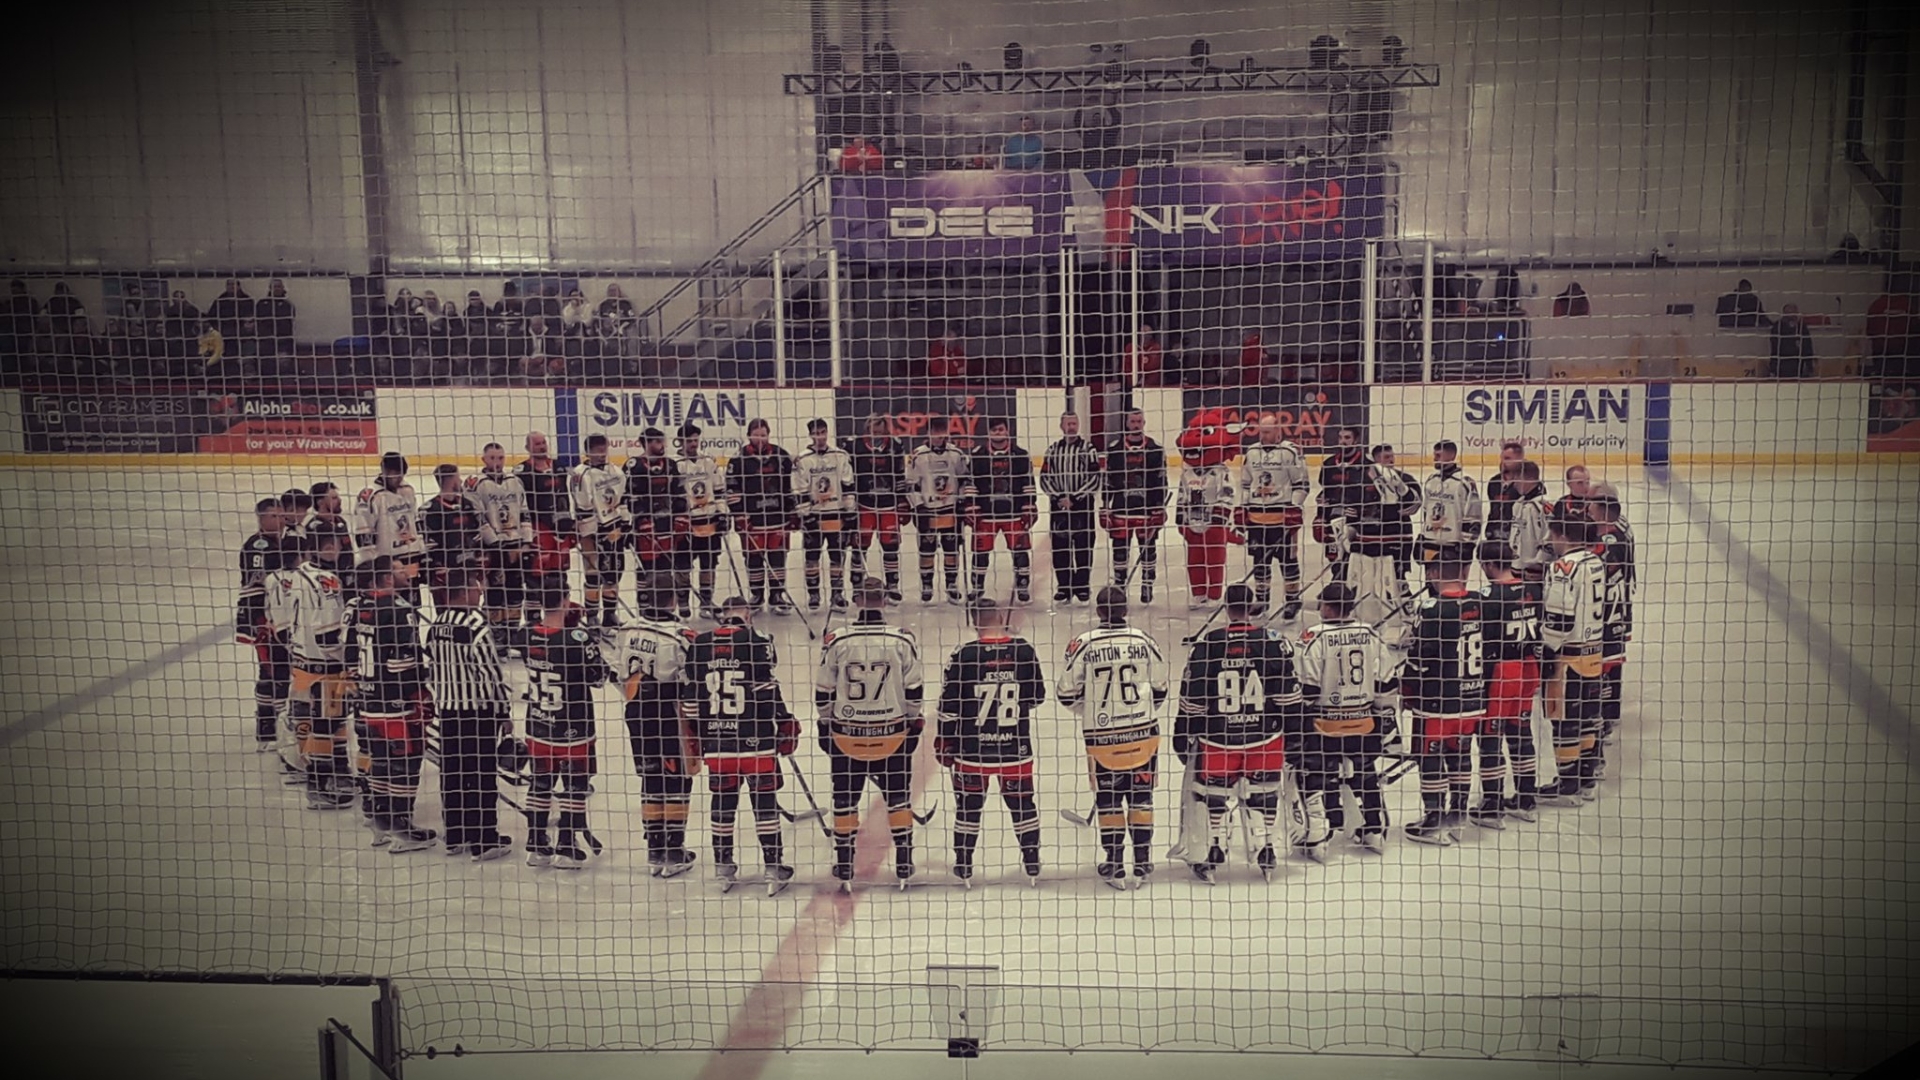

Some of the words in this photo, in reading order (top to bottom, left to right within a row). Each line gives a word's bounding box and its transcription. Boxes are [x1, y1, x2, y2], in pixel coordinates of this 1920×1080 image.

[890, 206, 1033, 237] DEE
[1065, 205, 1222, 235] RNK
[593, 392, 746, 427] SIMIAN
[1465, 389, 1630, 424] SIMIAN
[246, 439, 264, 449] for
[267, 440, 294, 451] your
[297, 438, 367, 449] Warehouse
[1465, 436, 1494, 447] Your
[1548, 435, 1572, 447] Our
[1337, 650, 1364, 686] 18
[1457, 633, 1483, 678] 18
[846, 662, 890, 701] 67
[983, 671, 1015, 682] JESSON
[1094, 664, 1140, 709] 76
[1218, 670, 1264, 713] 94
[974, 683, 1020, 727] 78
